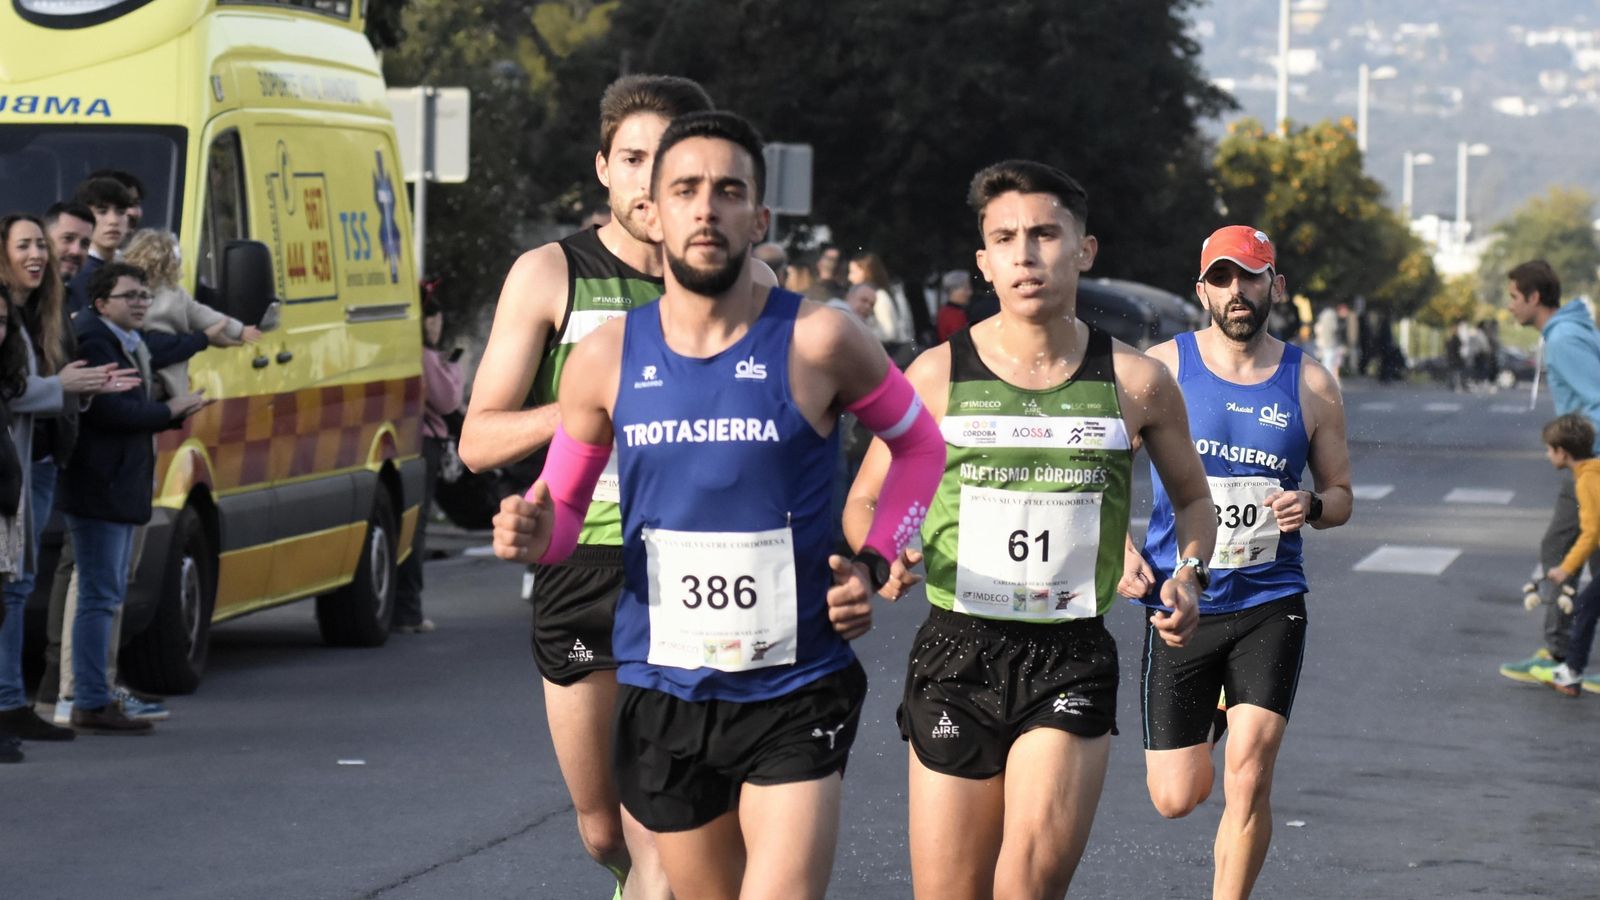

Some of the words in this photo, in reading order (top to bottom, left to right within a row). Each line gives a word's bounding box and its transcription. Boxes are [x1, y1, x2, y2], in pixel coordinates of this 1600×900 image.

[339, 211, 372, 262] TSS
[968, 400, 1002, 408] IMDECO
[623, 418, 780, 447] TROTASIERRA
[1193, 439, 1287, 471] OTASIERRA
[960, 463, 1029, 482] ATLETISMO
[1008, 529, 1049, 562] 61
[681, 575, 757, 609] 386
[972, 591, 1009, 603] IMDECO
[568, 650, 594, 658] AIRE
[932, 725, 960, 734] AIRE
